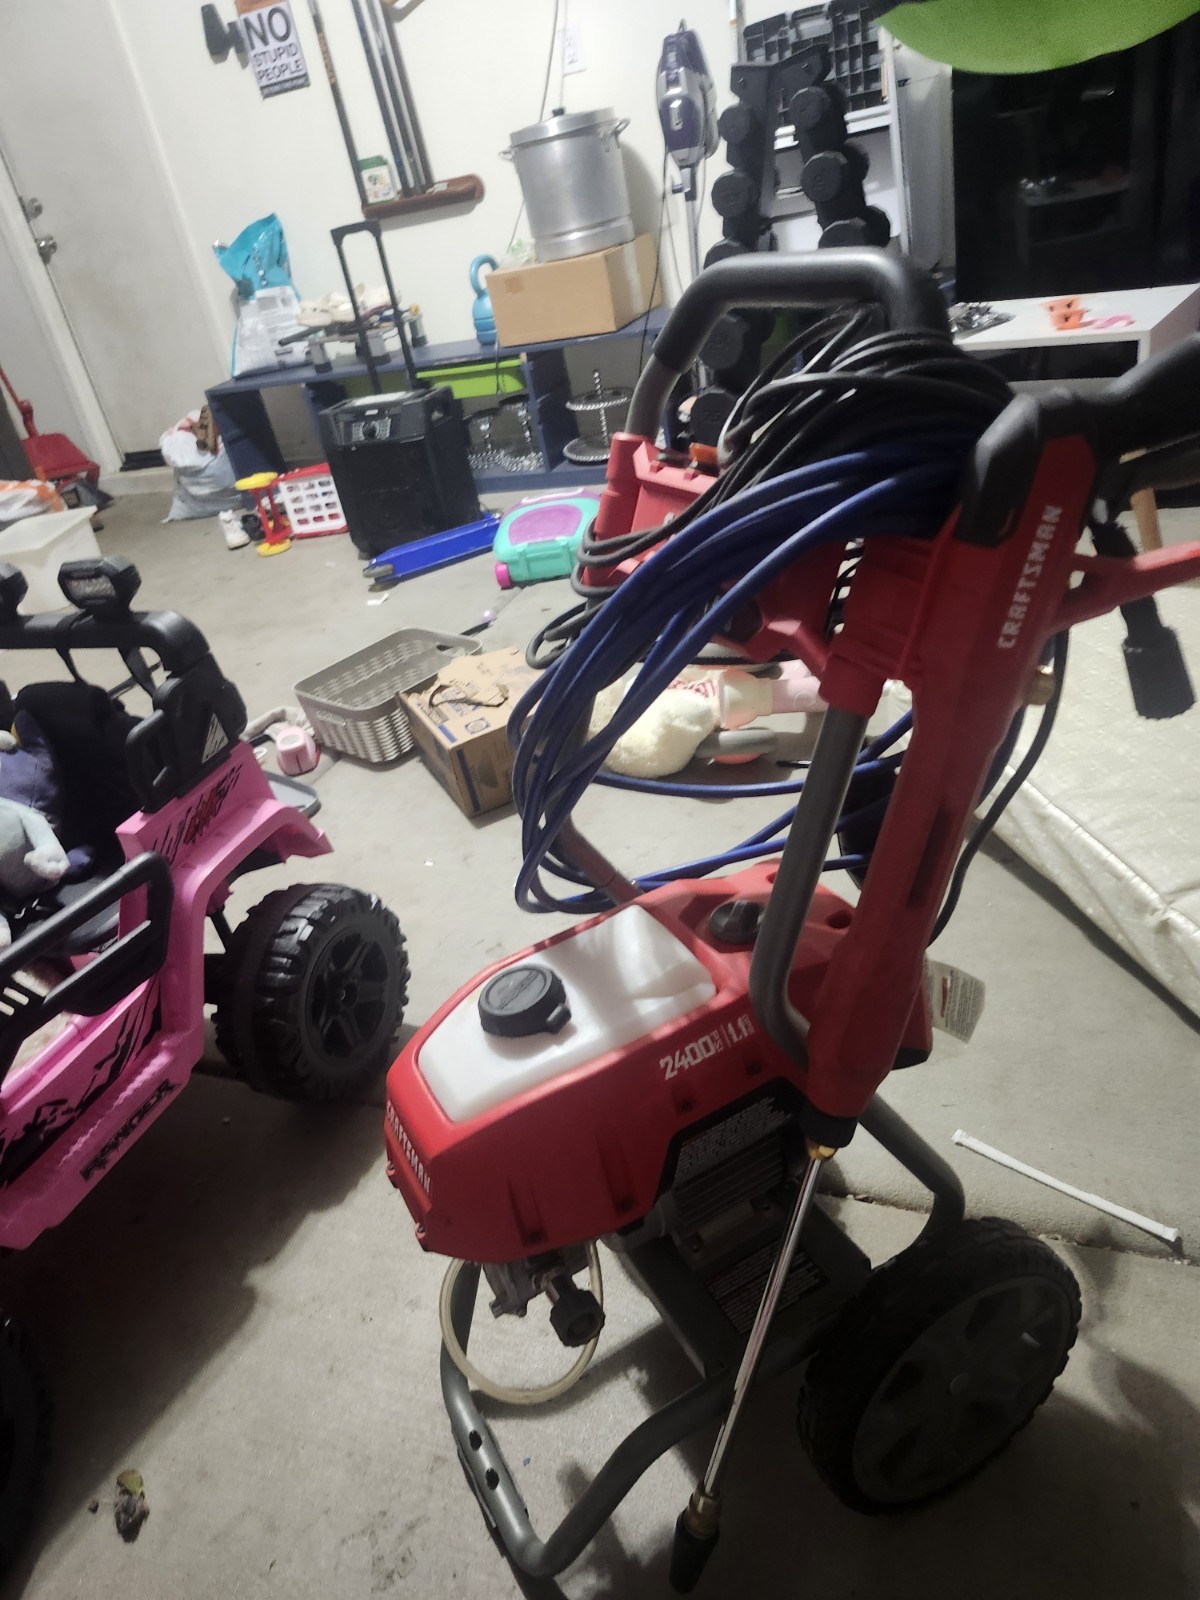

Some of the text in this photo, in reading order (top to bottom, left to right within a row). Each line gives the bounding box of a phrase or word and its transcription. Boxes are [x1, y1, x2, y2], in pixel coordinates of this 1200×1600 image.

[243, 7, 291, 50] NO
[253, 43, 298, 67] STUPID
[256, 60, 303, 80] PEOPLE
[998, 505, 1062, 649] CRAFTSMAN
[659, 1034, 717, 1081] 2400
[386, 1099, 431, 1193] CRAFTSMAN
